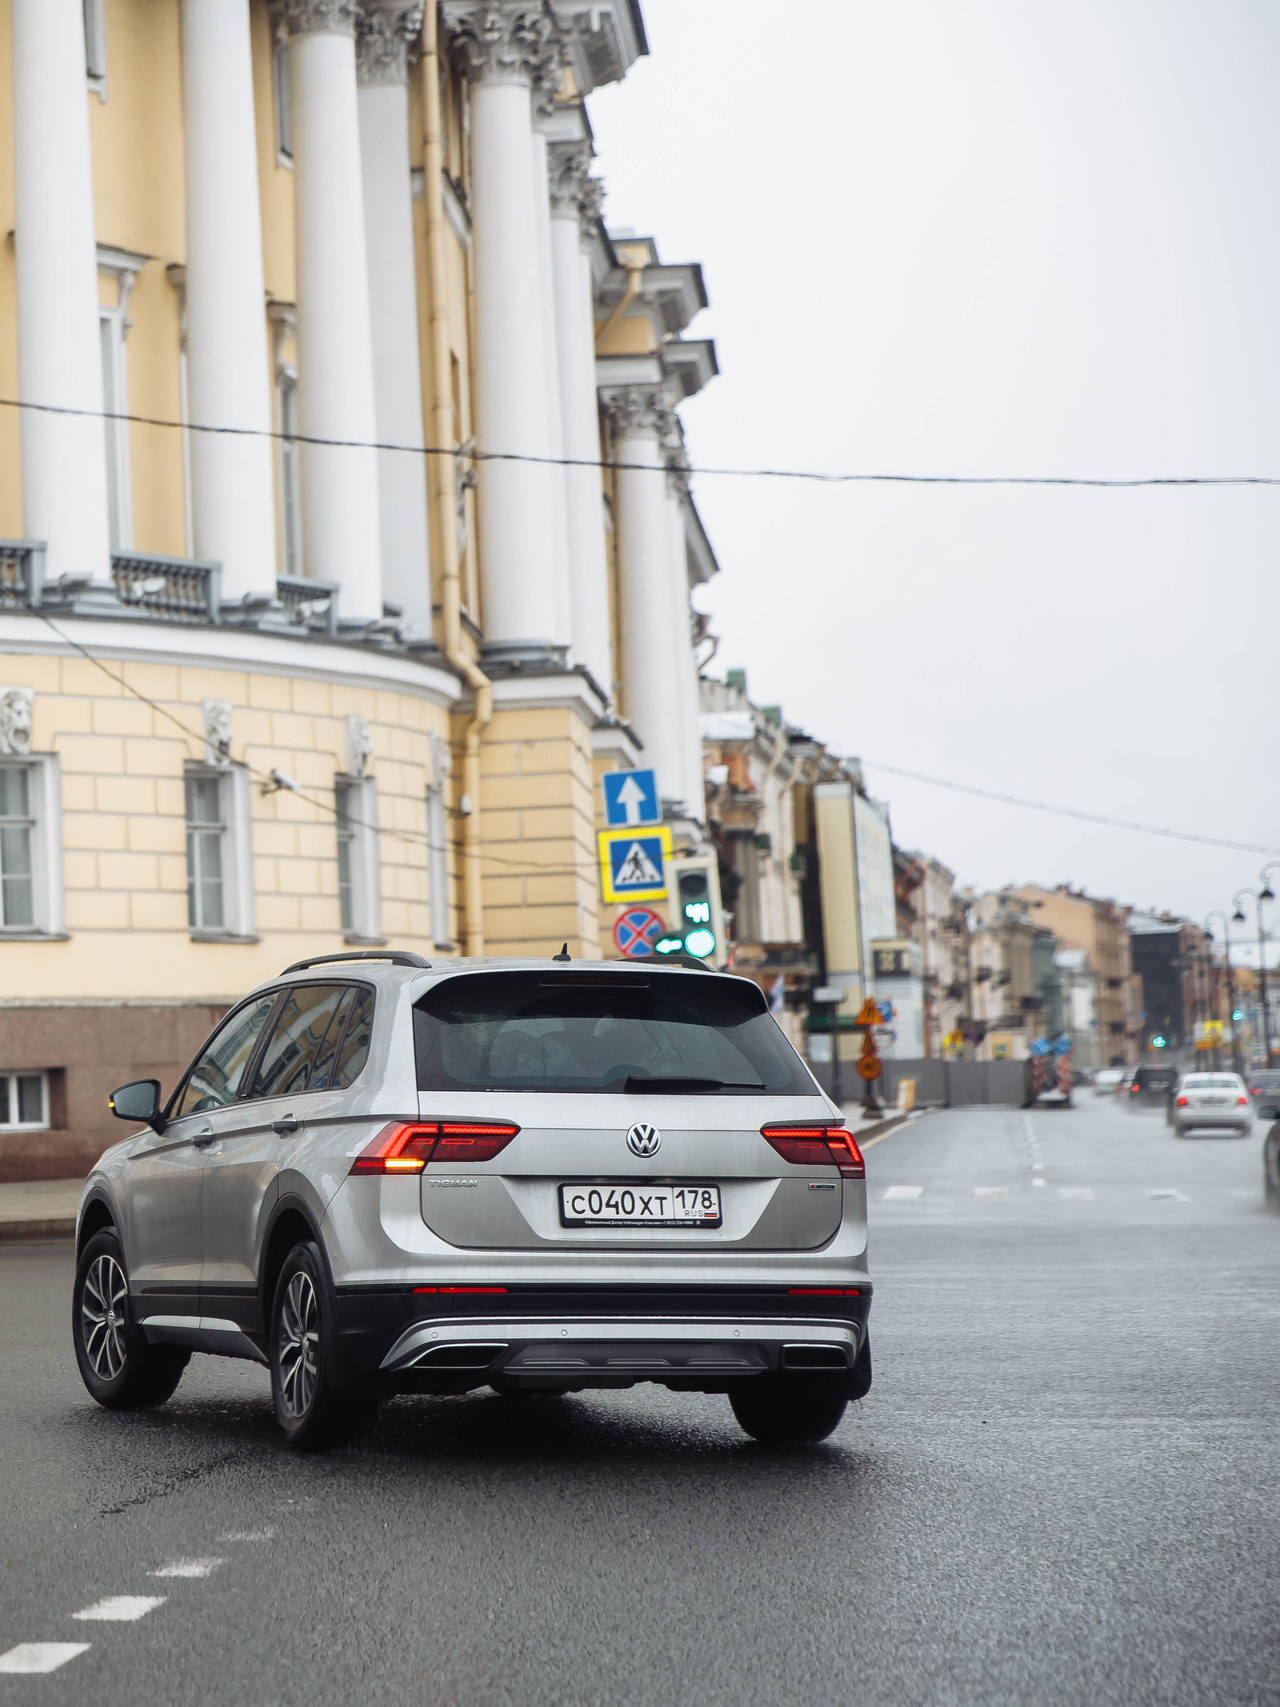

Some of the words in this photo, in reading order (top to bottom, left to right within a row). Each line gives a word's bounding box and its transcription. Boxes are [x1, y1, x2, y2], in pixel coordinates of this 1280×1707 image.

[428, 1179, 479, 1188] TIGUAN
[675, 1189, 713, 1210] 178
[684, 1210, 704, 1218] RUS
